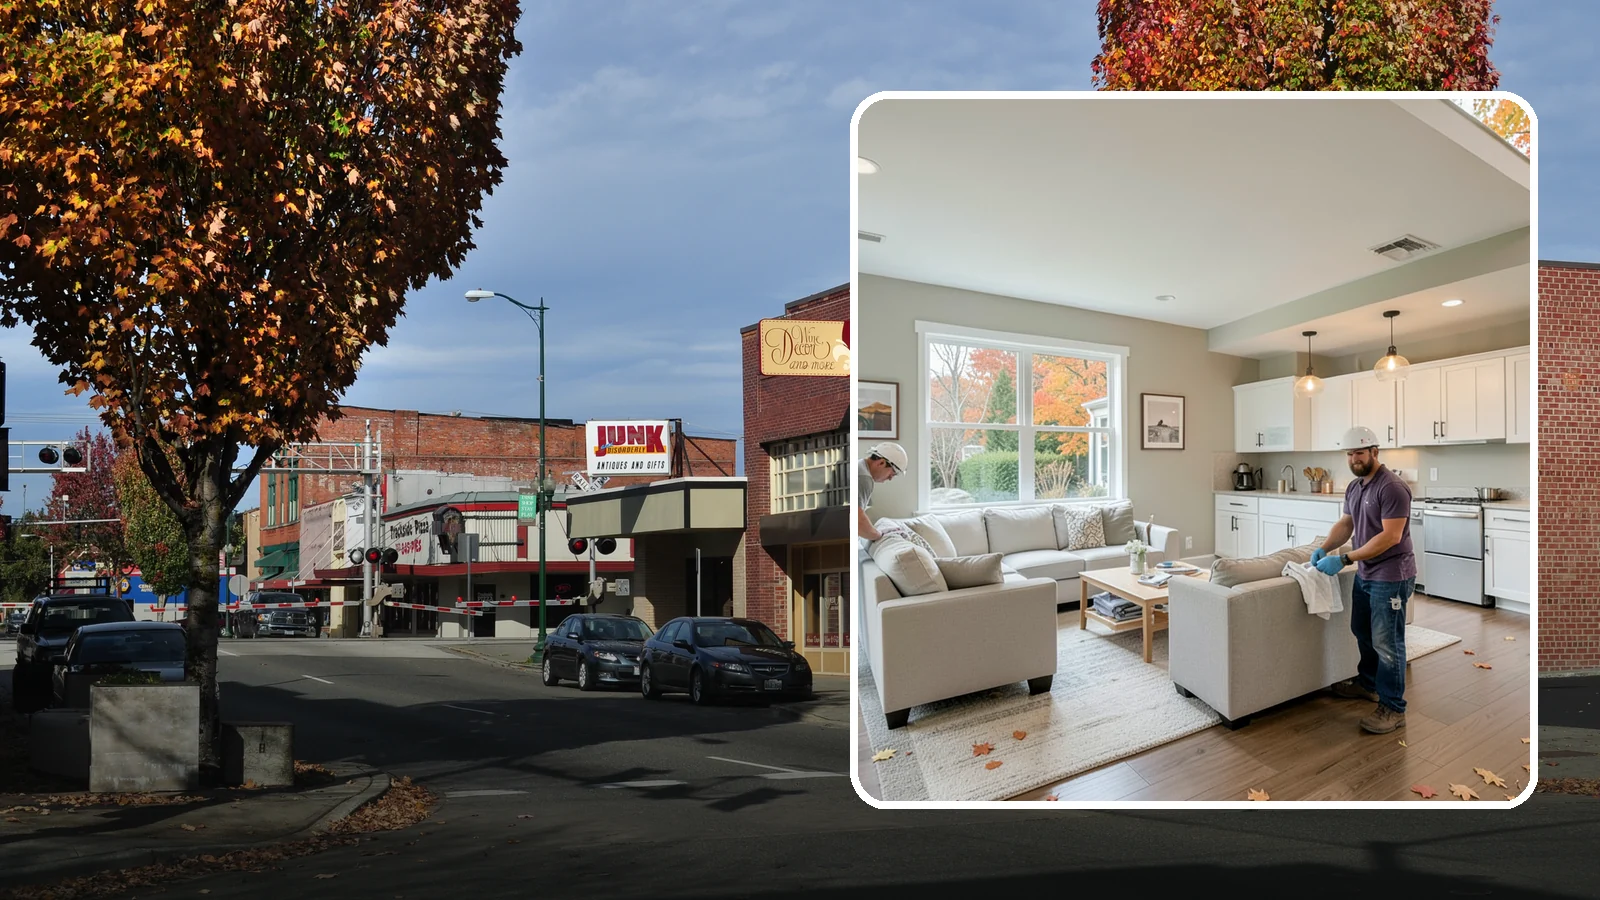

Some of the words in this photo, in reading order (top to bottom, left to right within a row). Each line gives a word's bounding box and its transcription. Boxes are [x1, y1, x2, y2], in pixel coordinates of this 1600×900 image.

[595, 425, 665, 457] JUNK
[597, 461, 628, 470] ANTIQUES
[631, 461, 643, 470] AND
[647, 461, 665, 469] GIFTS
[573, 473, 589, 492] RAIL
[415, 520, 429, 534] Pizza
